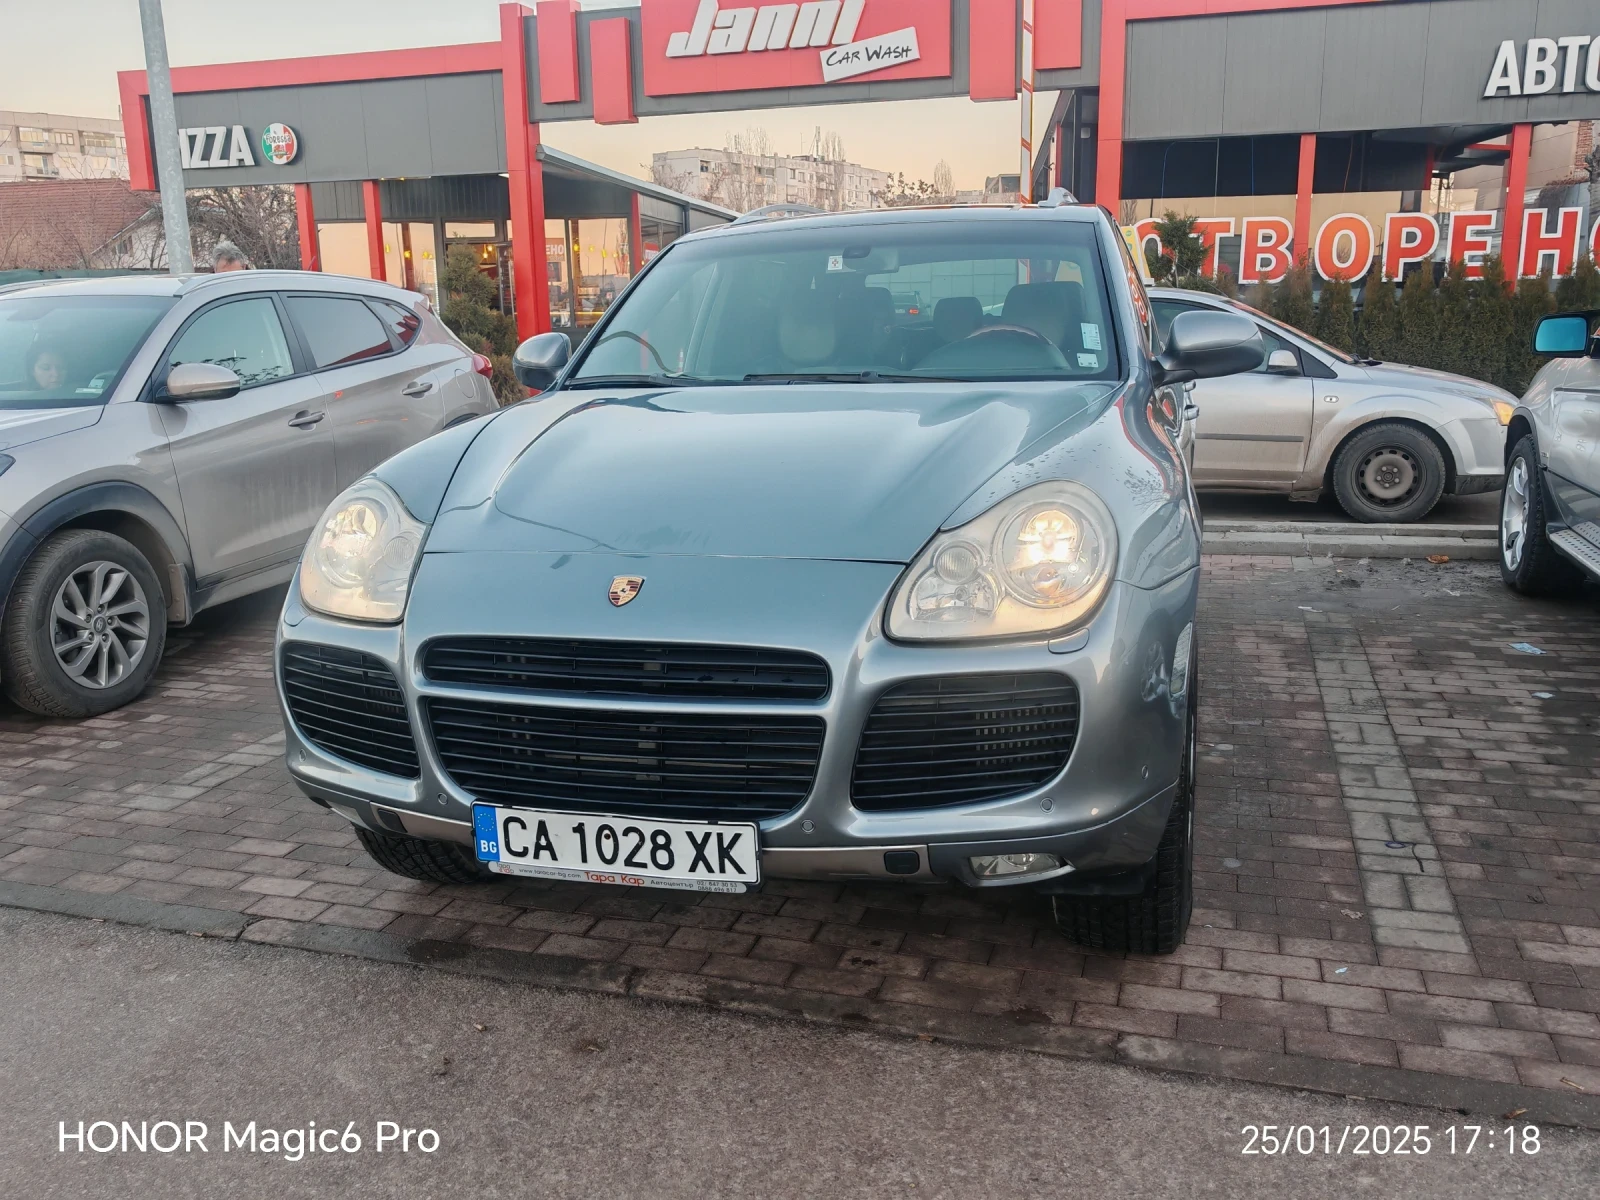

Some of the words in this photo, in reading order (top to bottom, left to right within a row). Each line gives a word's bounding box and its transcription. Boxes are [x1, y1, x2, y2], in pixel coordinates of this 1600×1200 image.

[826, 50, 860, 66] CAR
[865, 45, 912, 61] WASH
[178, 124, 255, 169] IZZA
[480, 839, 497, 853] BG
[503, 815, 558, 861] CA
[572, 821, 675, 871] 1028
[685, 830, 746, 875] XK
[584, 871, 615, 883] Тара
[621, 874, 645, 887] Кар
